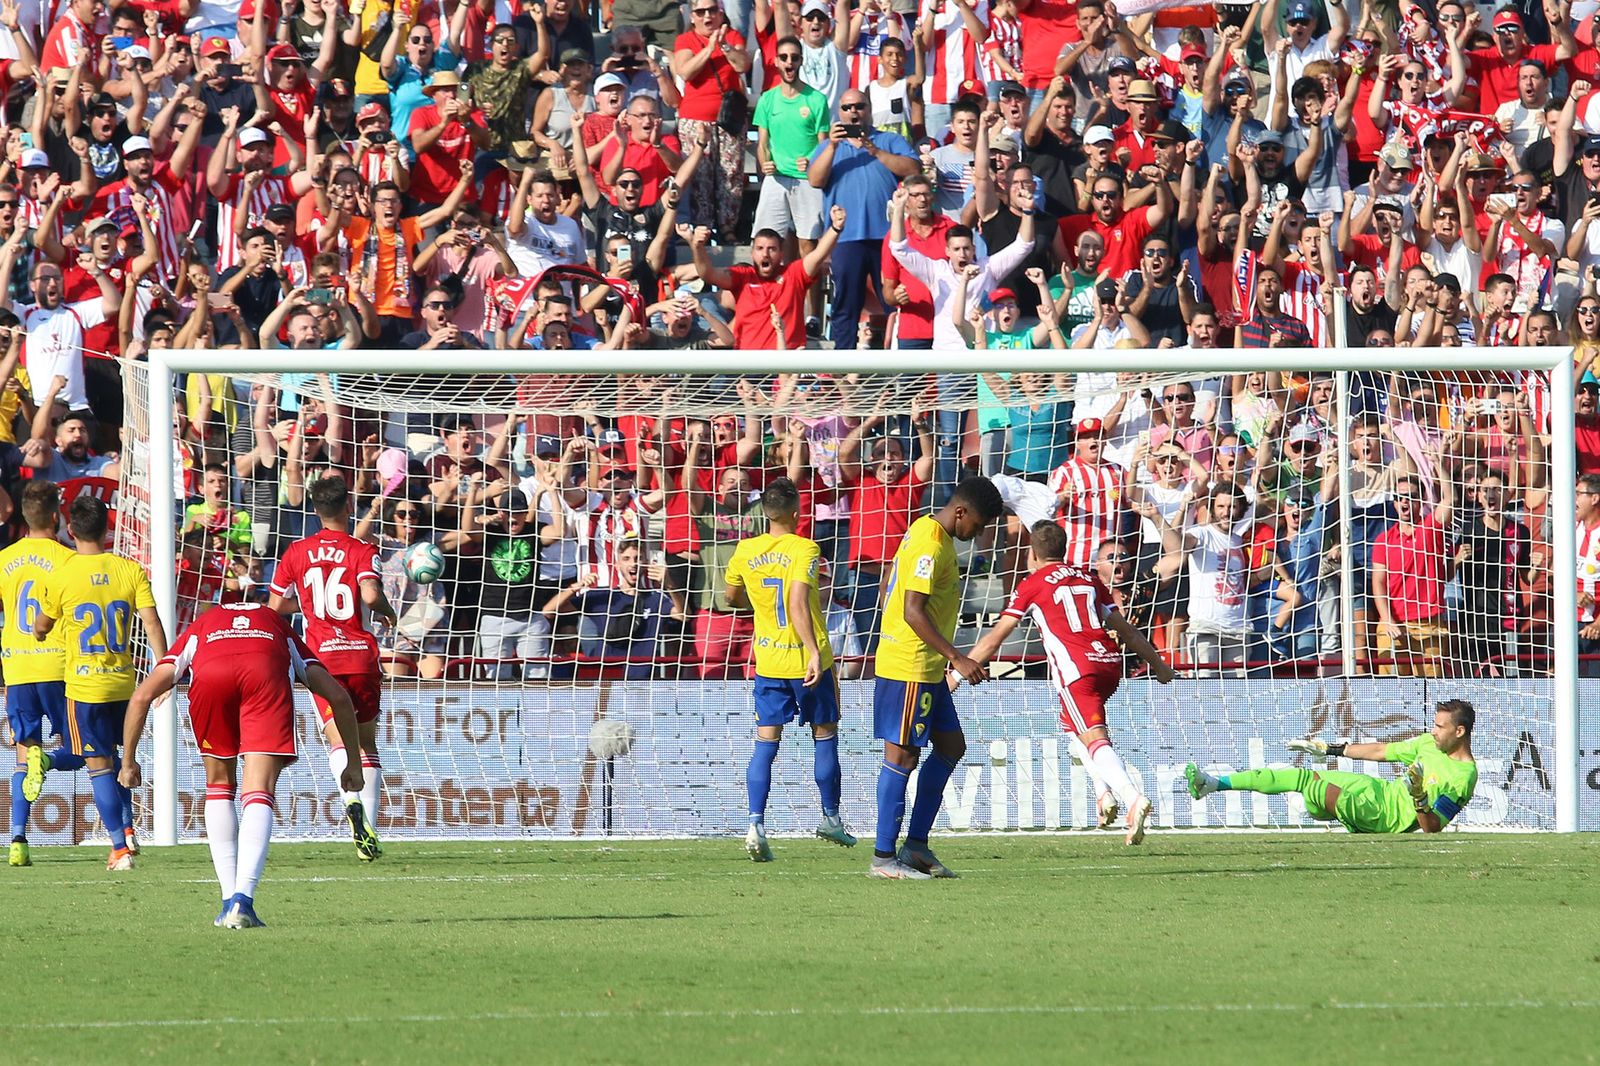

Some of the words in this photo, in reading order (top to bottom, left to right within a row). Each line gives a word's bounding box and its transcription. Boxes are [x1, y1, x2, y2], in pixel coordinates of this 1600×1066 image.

[3, 556, 25, 577] JOSE
[307, 546, 346, 564] LAZO
[90, 573, 110, 586] IZA
[303, 566, 355, 621] 16
[761, 577, 788, 629] 7
[17, 580, 42, 635] 6
[73, 600, 131, 656] 20
[1053, 585, 1101, 633] 17
[435, 697, 516, 744] For
[919, 692, 932, 718] 9
